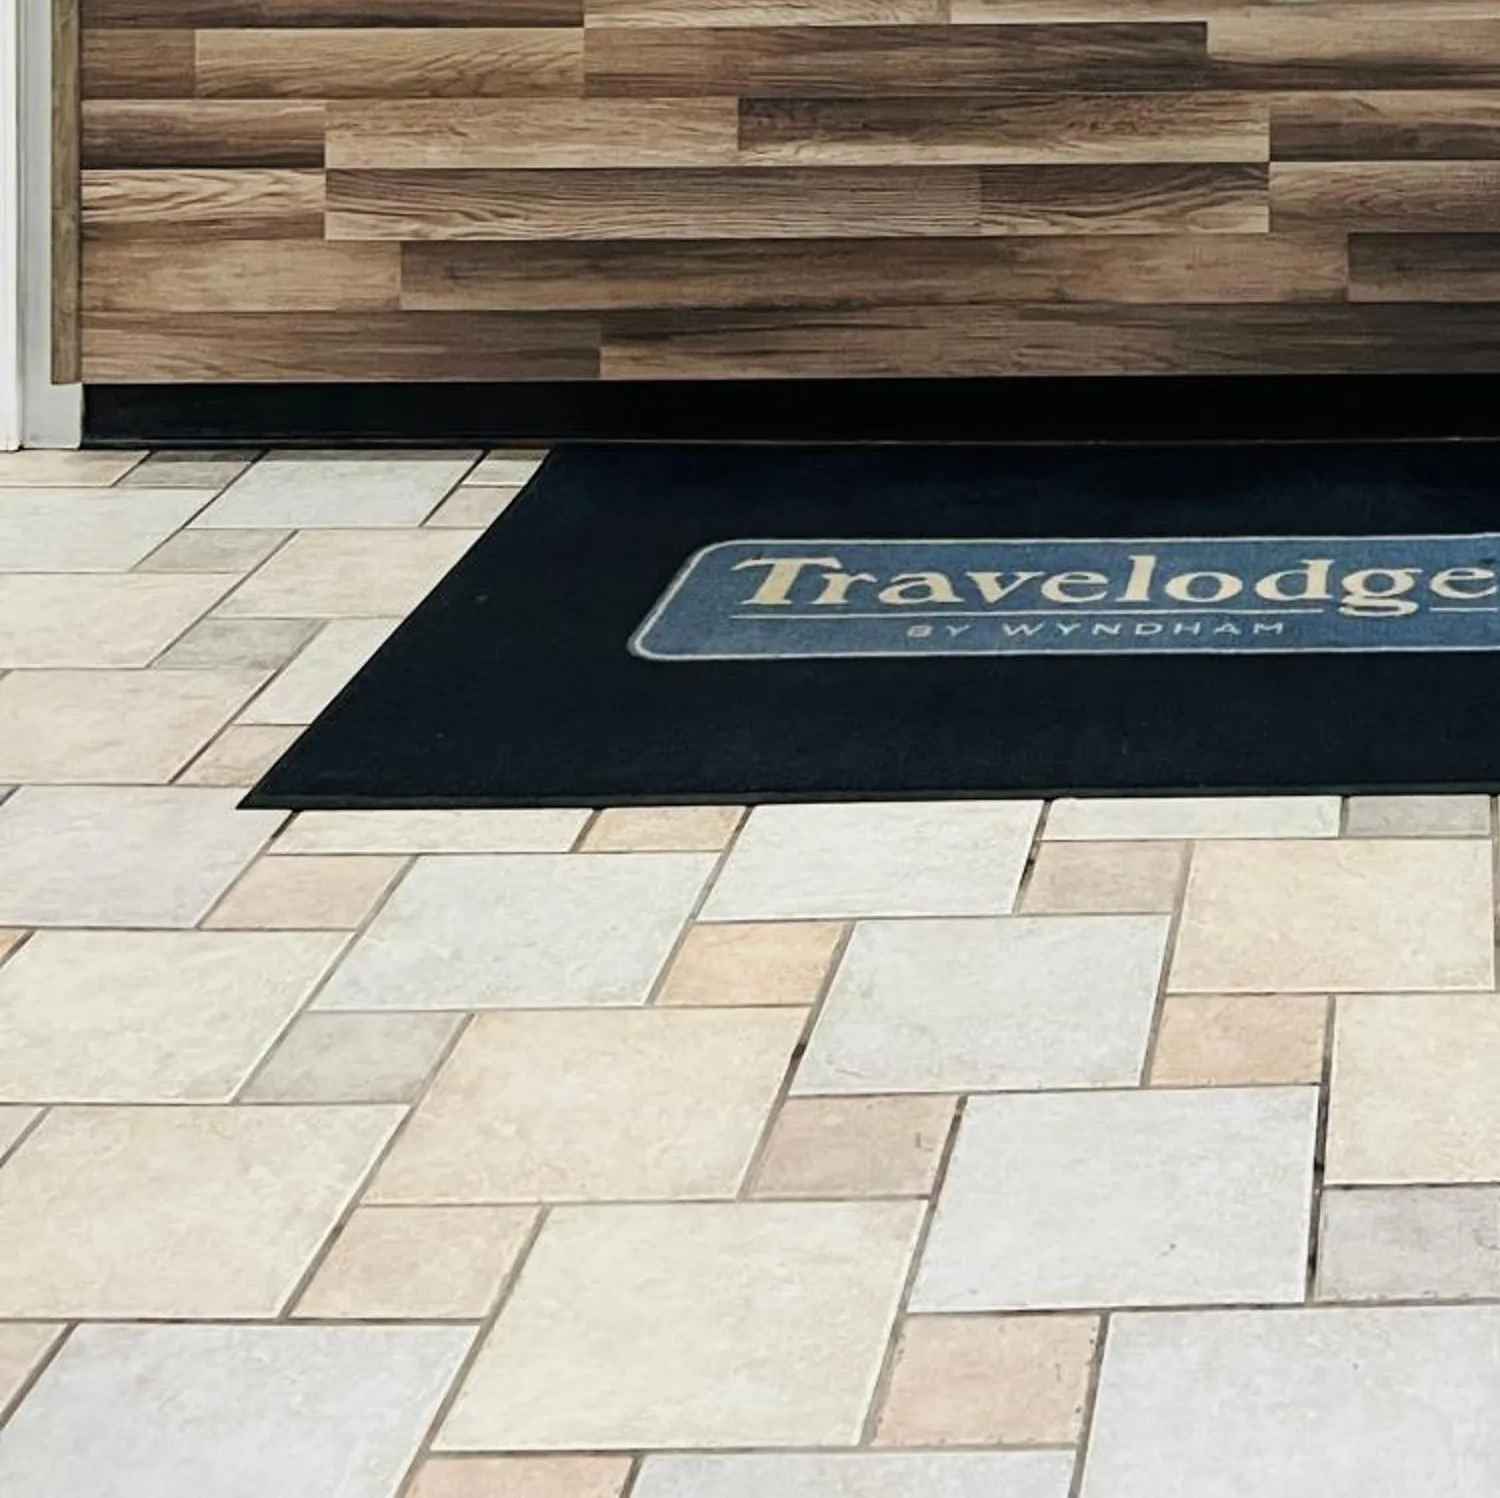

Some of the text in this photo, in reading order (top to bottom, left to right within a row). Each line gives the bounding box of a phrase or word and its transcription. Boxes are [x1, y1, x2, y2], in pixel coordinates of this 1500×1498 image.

[731, 555, 1498, 617] Travelodge
[906, 622, 1284, 639] BY WYNDHAM
